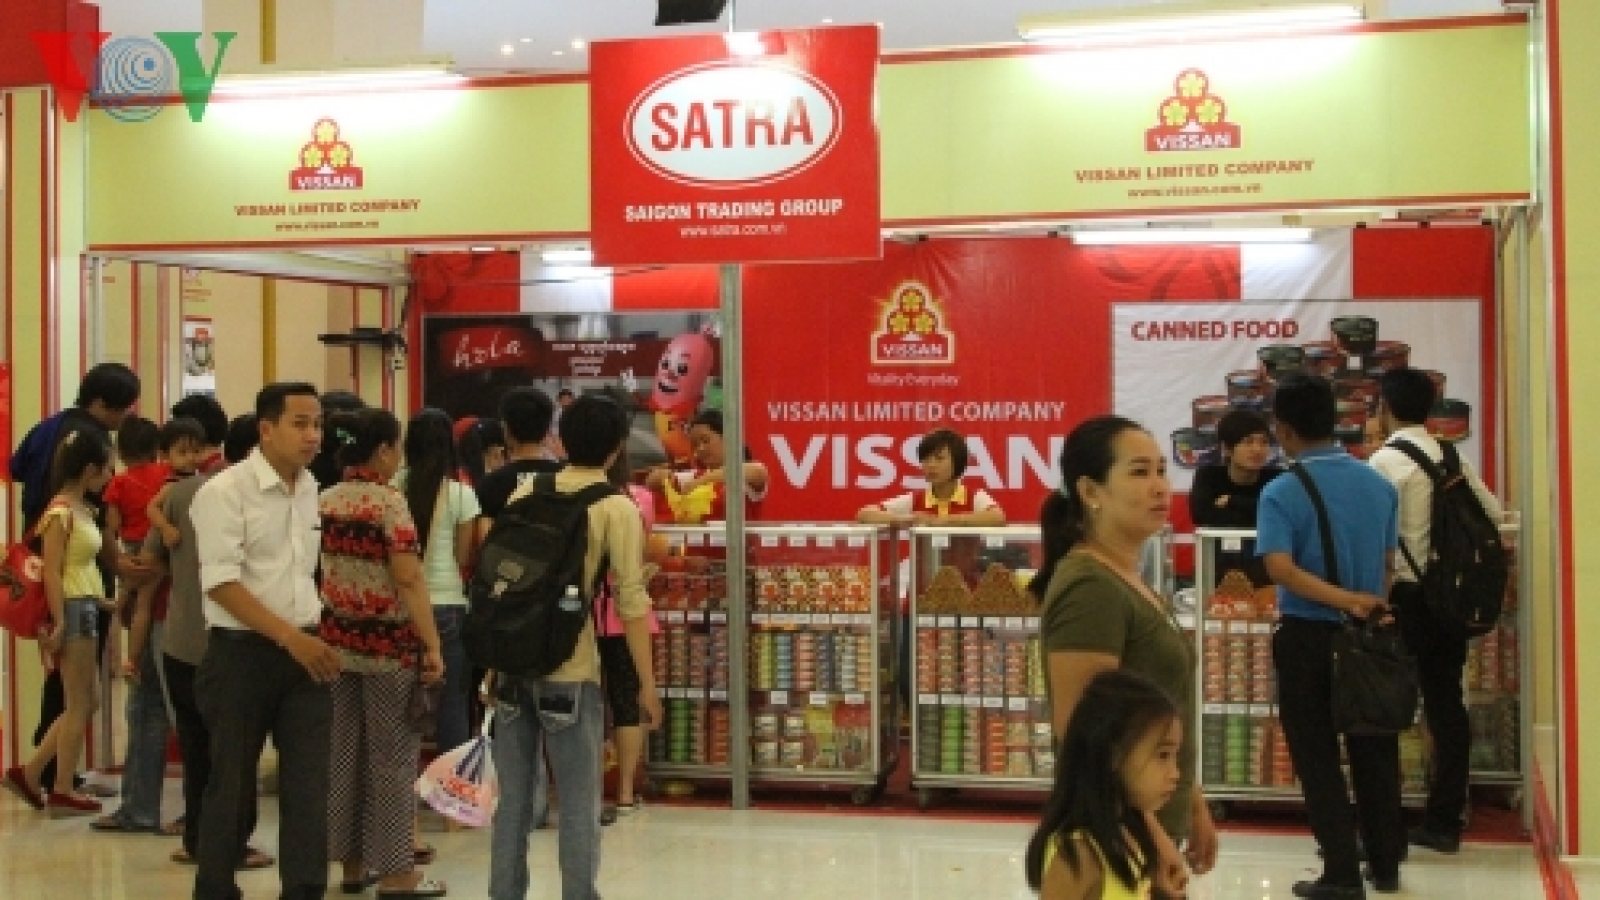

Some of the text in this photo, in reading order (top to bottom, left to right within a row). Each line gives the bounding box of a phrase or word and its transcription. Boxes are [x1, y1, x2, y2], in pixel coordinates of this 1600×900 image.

[650, 96, 814, 151] SATRA
[1155, 134, 1232, 150] VISSAN
[1075, 158, 1315, 183] VISSAN LIMITED COMPANY
[297, 175, 356, 189] VISSAN
[234, 199, 420, 217] VISSAN LIMITED COMPANY
[625, 199, 843, 222] SAIGON TRADING GROUP
[1130, 319, 1299, 341] CANNED FOOD
[881, 343, 944, 358] VISSAN
[767, 402, 1066, 422] VISSAN LIMITED COMPANY
